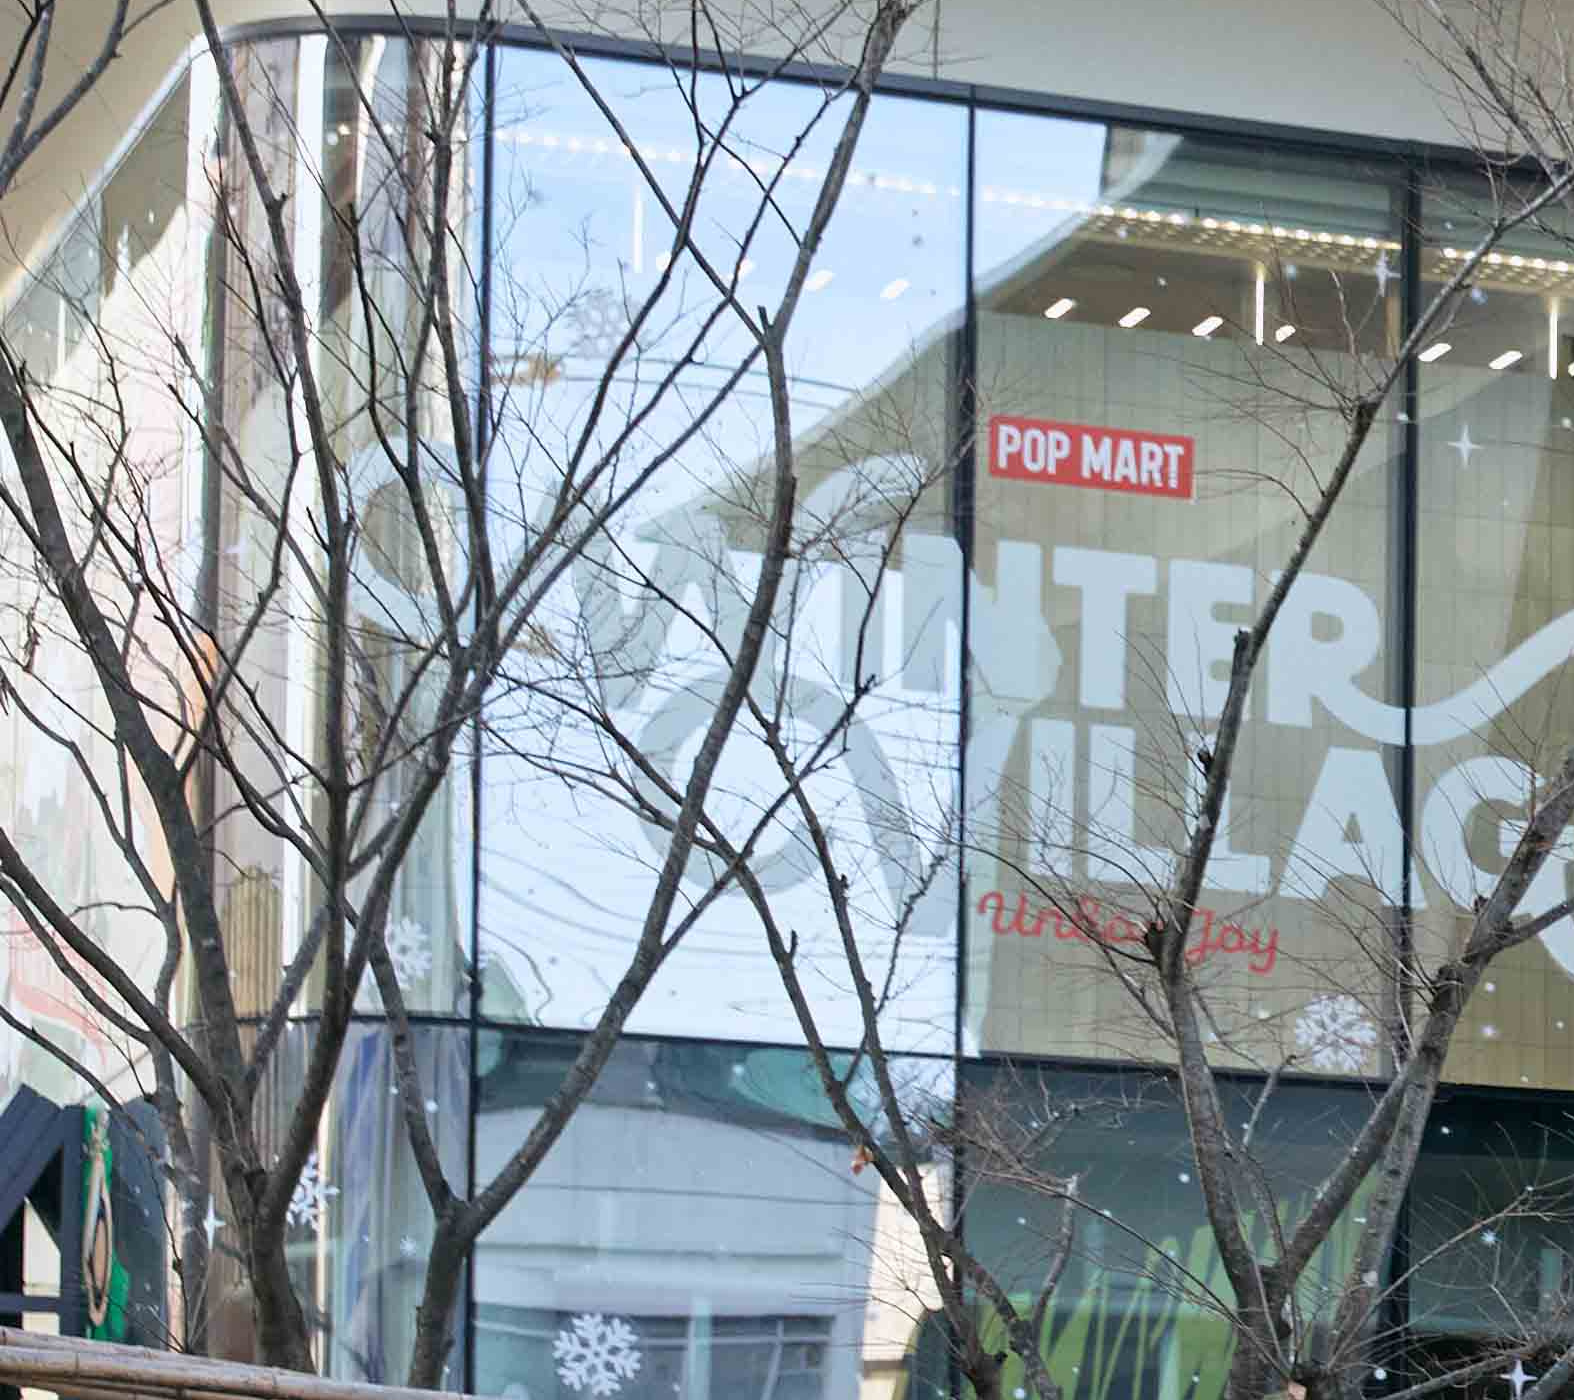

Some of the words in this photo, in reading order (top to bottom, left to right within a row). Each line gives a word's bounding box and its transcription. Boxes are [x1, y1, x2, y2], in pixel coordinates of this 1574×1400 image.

[997, 424, 1071, 475] POP
[1080, 434, 1185, 489] MART
[1184, 906, 1280, 974] Joy
